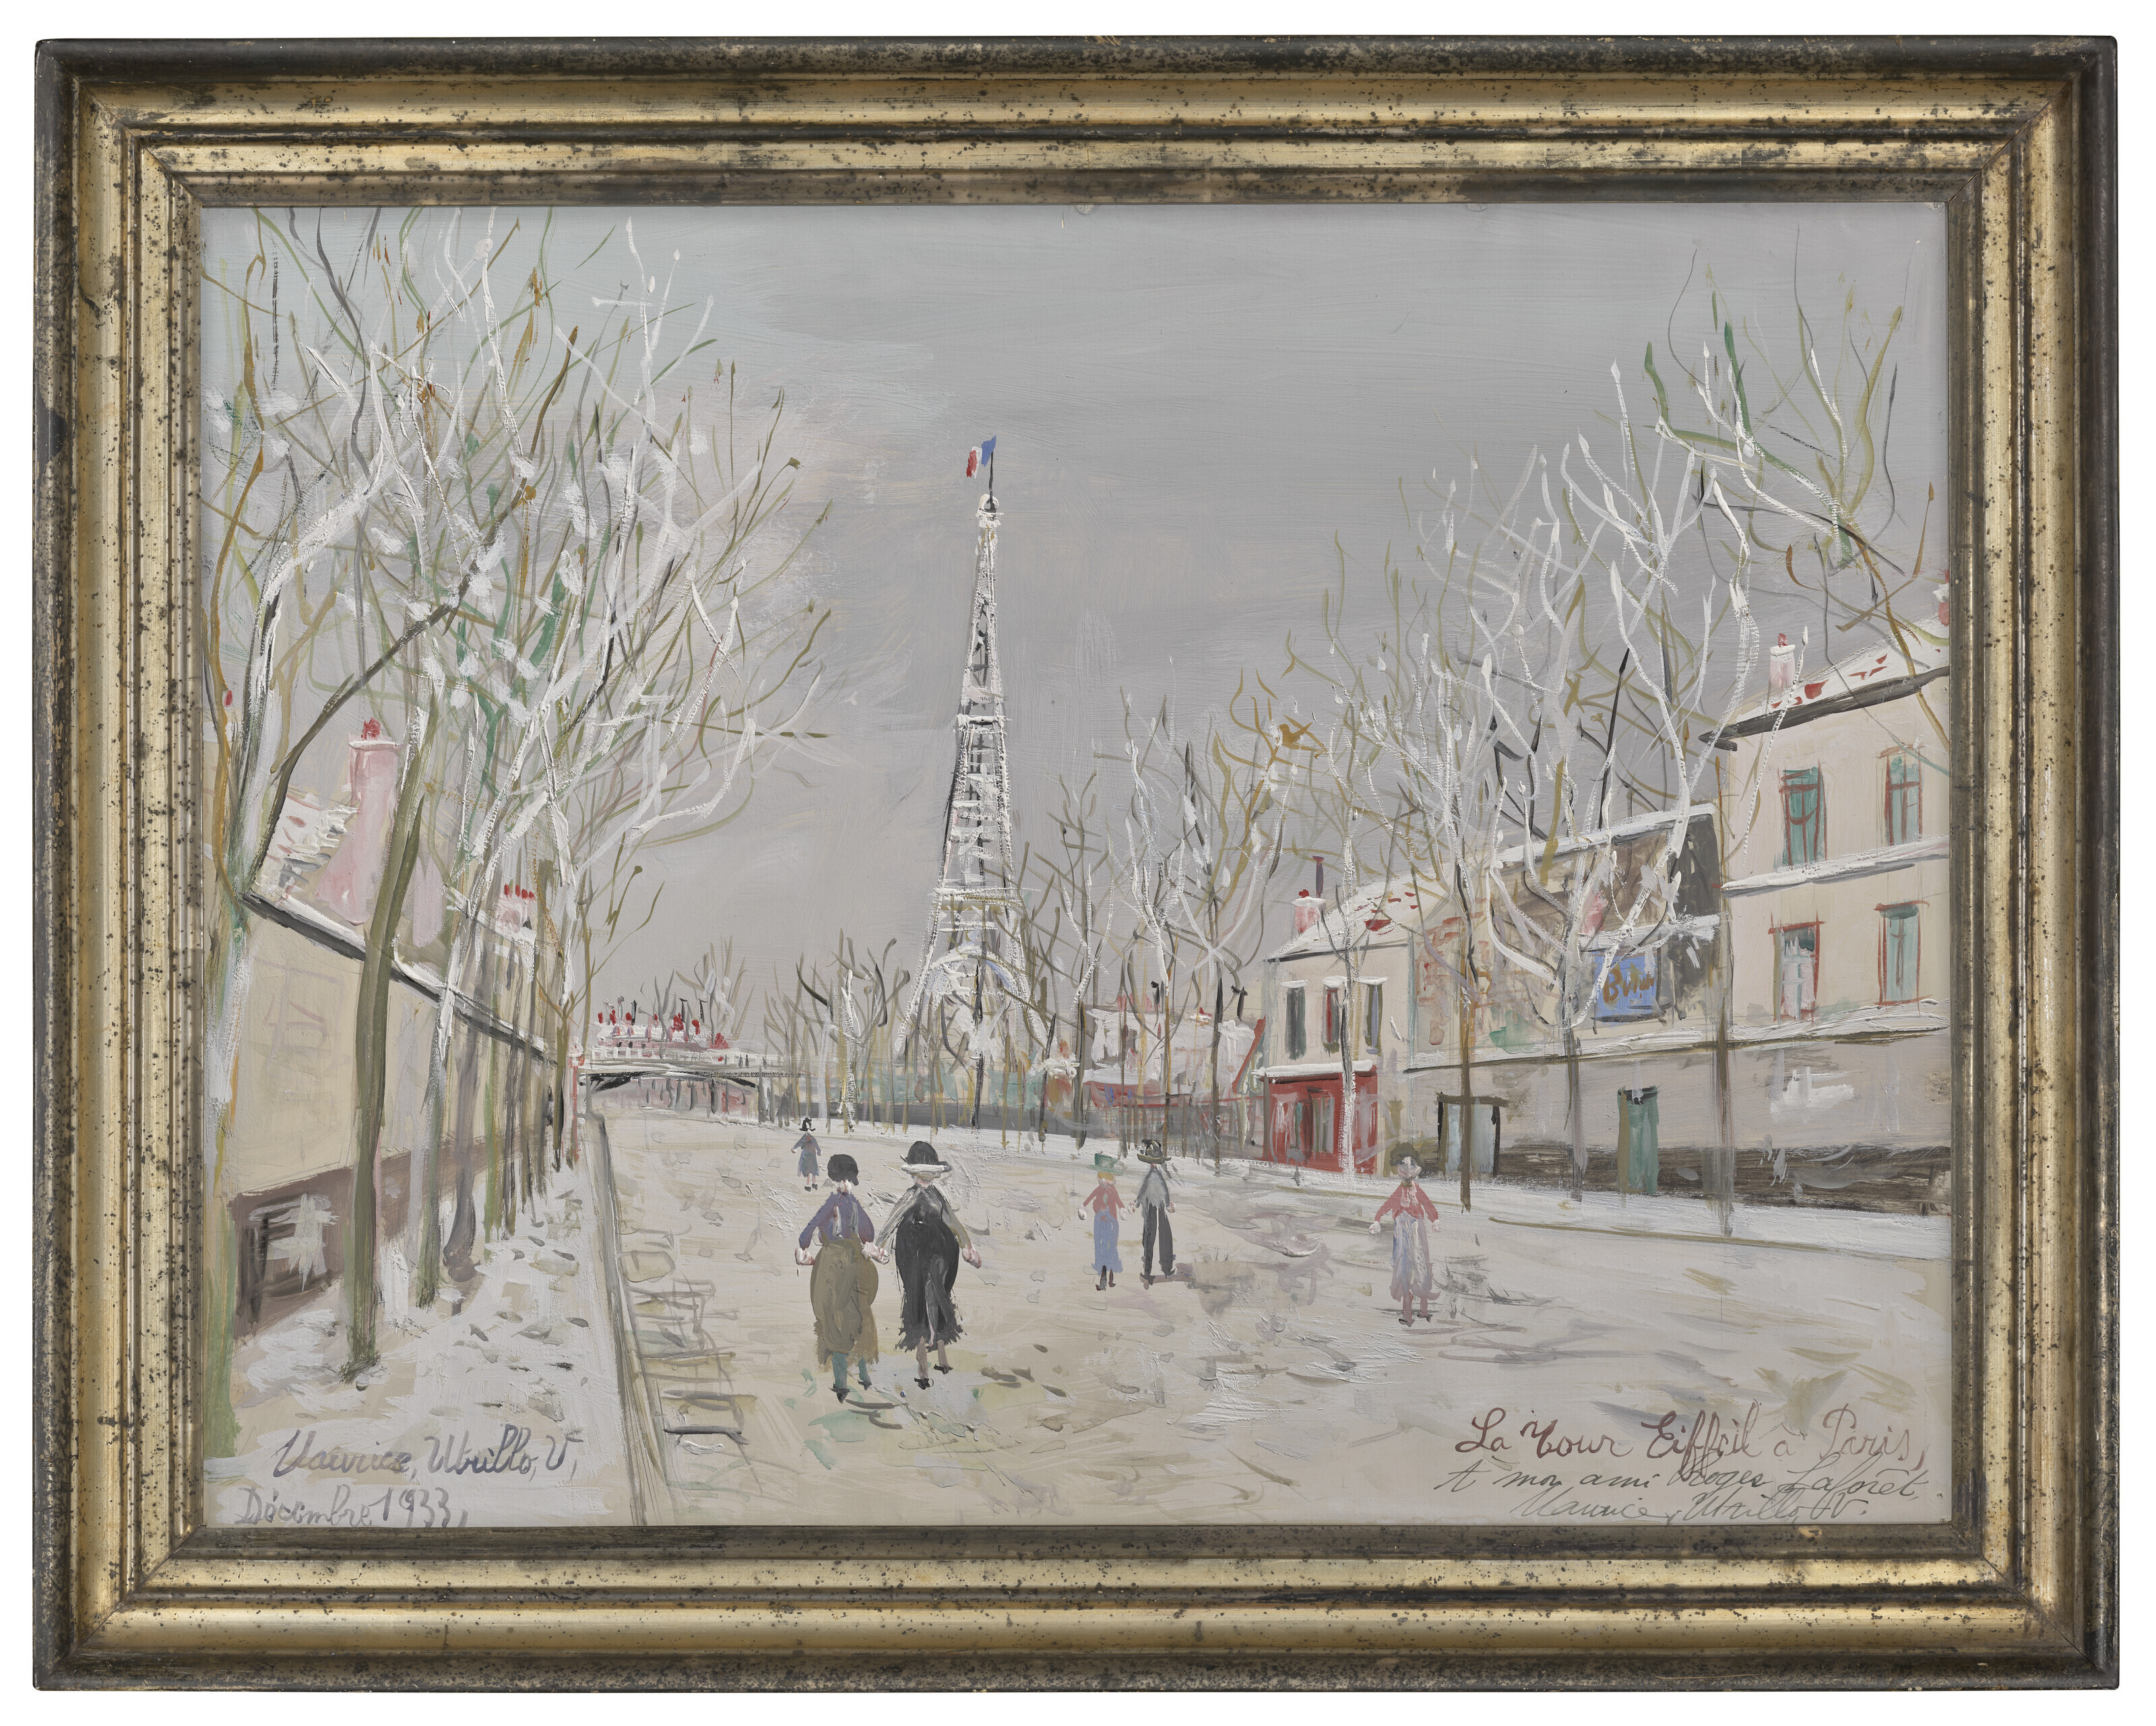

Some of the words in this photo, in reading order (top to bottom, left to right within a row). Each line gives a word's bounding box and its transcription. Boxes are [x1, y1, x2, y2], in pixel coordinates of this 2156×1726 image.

[1455, 1407, 1513, 1453] La
[1493, 1471, 1563, 1488] mon
[1579, 1472, 1661, 1488] ami
